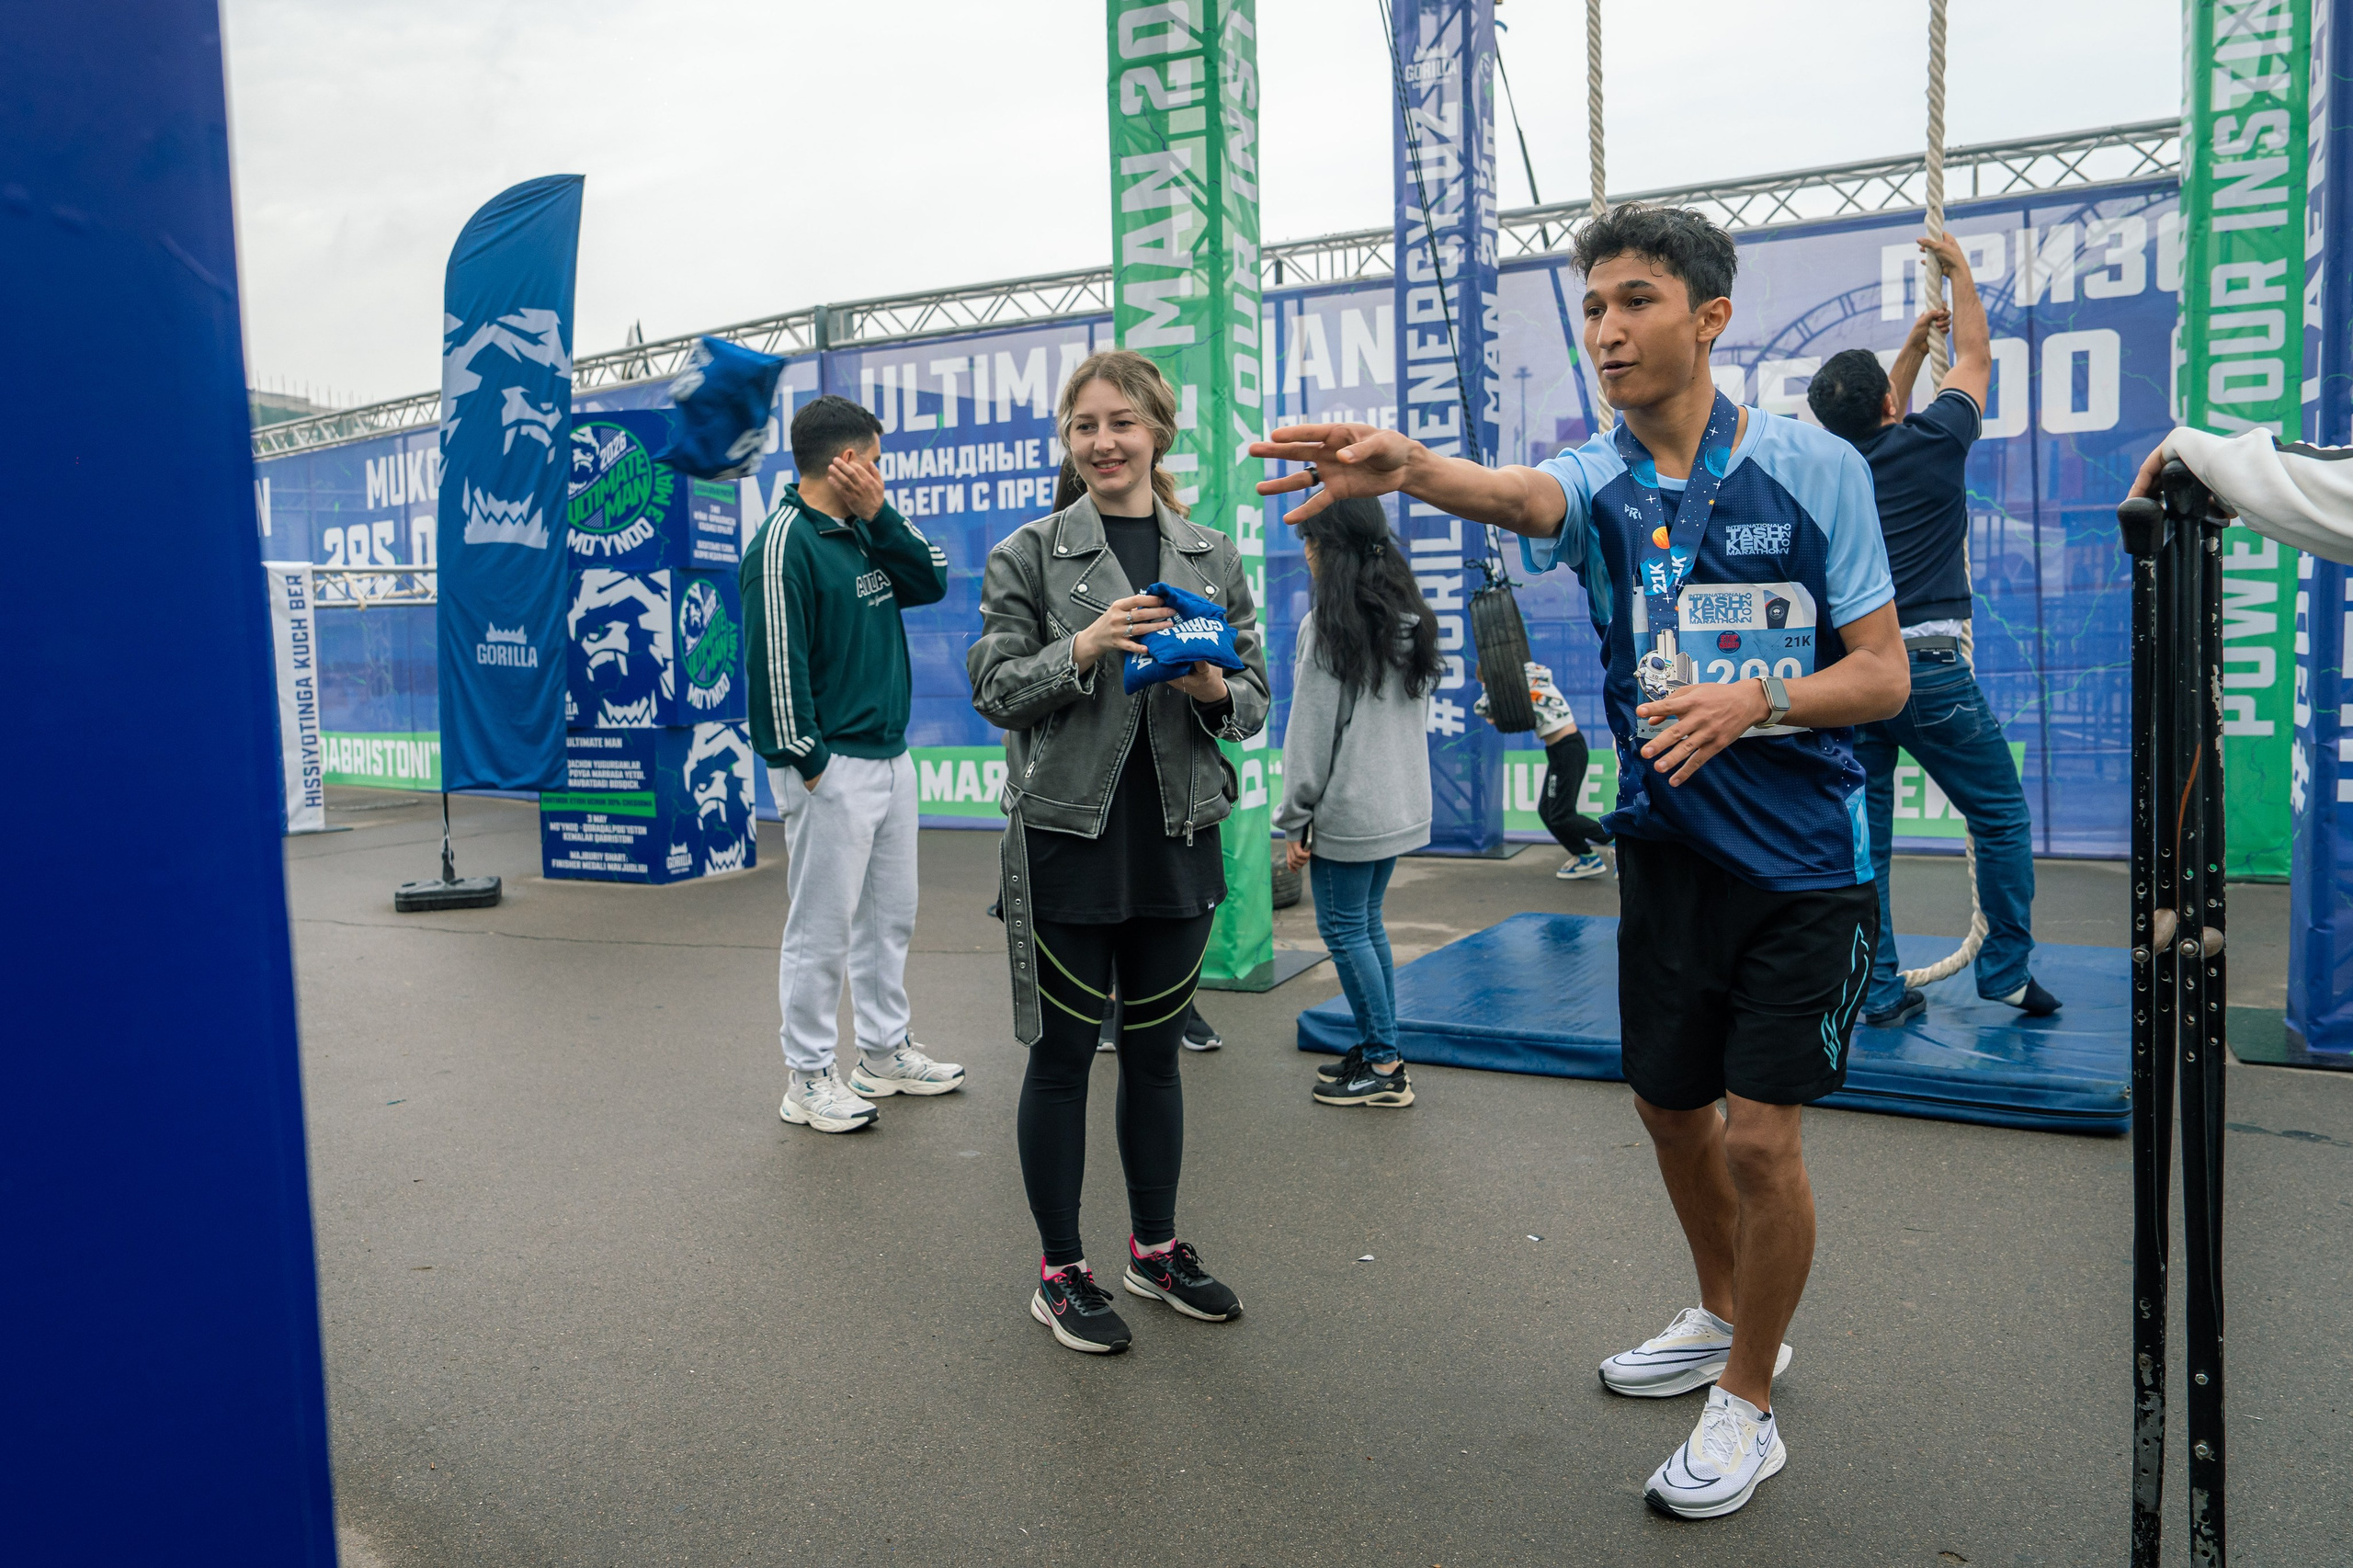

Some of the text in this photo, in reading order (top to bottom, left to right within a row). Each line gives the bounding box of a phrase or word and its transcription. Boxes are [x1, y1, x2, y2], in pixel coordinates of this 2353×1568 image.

[1404, 58, 1458, 82] GORILLA
[1121, 147, 1195, 349] MAN
[1233, 232, 1263, 466] YOUR
[1264, 305, 1394, 397] AN
[2208, 258, 2287, 437] YOUR
[1405, 102, 1467, 737] #ORILLENERGY.UZ
[599, 430, 627, 472] 2026
[568, 453, 648, 523] ULTIMATE
[606, 474, 649, 528] MAN
[645, 463, 675, 523] 3 MAY
[972, 482, 990, 512] С
[1726, 527, 1783, 540] TASH
[1726, 538, 1779, 551] KENT
[1781, 523, 1791, 555] 2026
[1726, 548, 1783, 556] MARATHON
[1649, 562, 1668, 594] 21K
[1672, 555, 1688, 587] 1K
[1688, 597, 1744, 609] TASH
[1688, 608, 1742, 619] KENT
[1742, 592, 1752, 623] 2026
[1720, 634, 1739, 642] STOP
[1784, 635, 1812, 648] 21K
[2223, 517, 2279, 736] POWE
[477, 643, 538, 668] GORILLA
[1236, 505, 1267, 810] PER
[286, 574, 324, 808] HISSIYOTINGA KUCH BER
[566, 737, 622, 748] ULTIMATE MAN
[920, 760, 1009, 802] МАЯ
[593, 814, 608, 824] MAY
[666, 853, 693, 869] GORILLA
